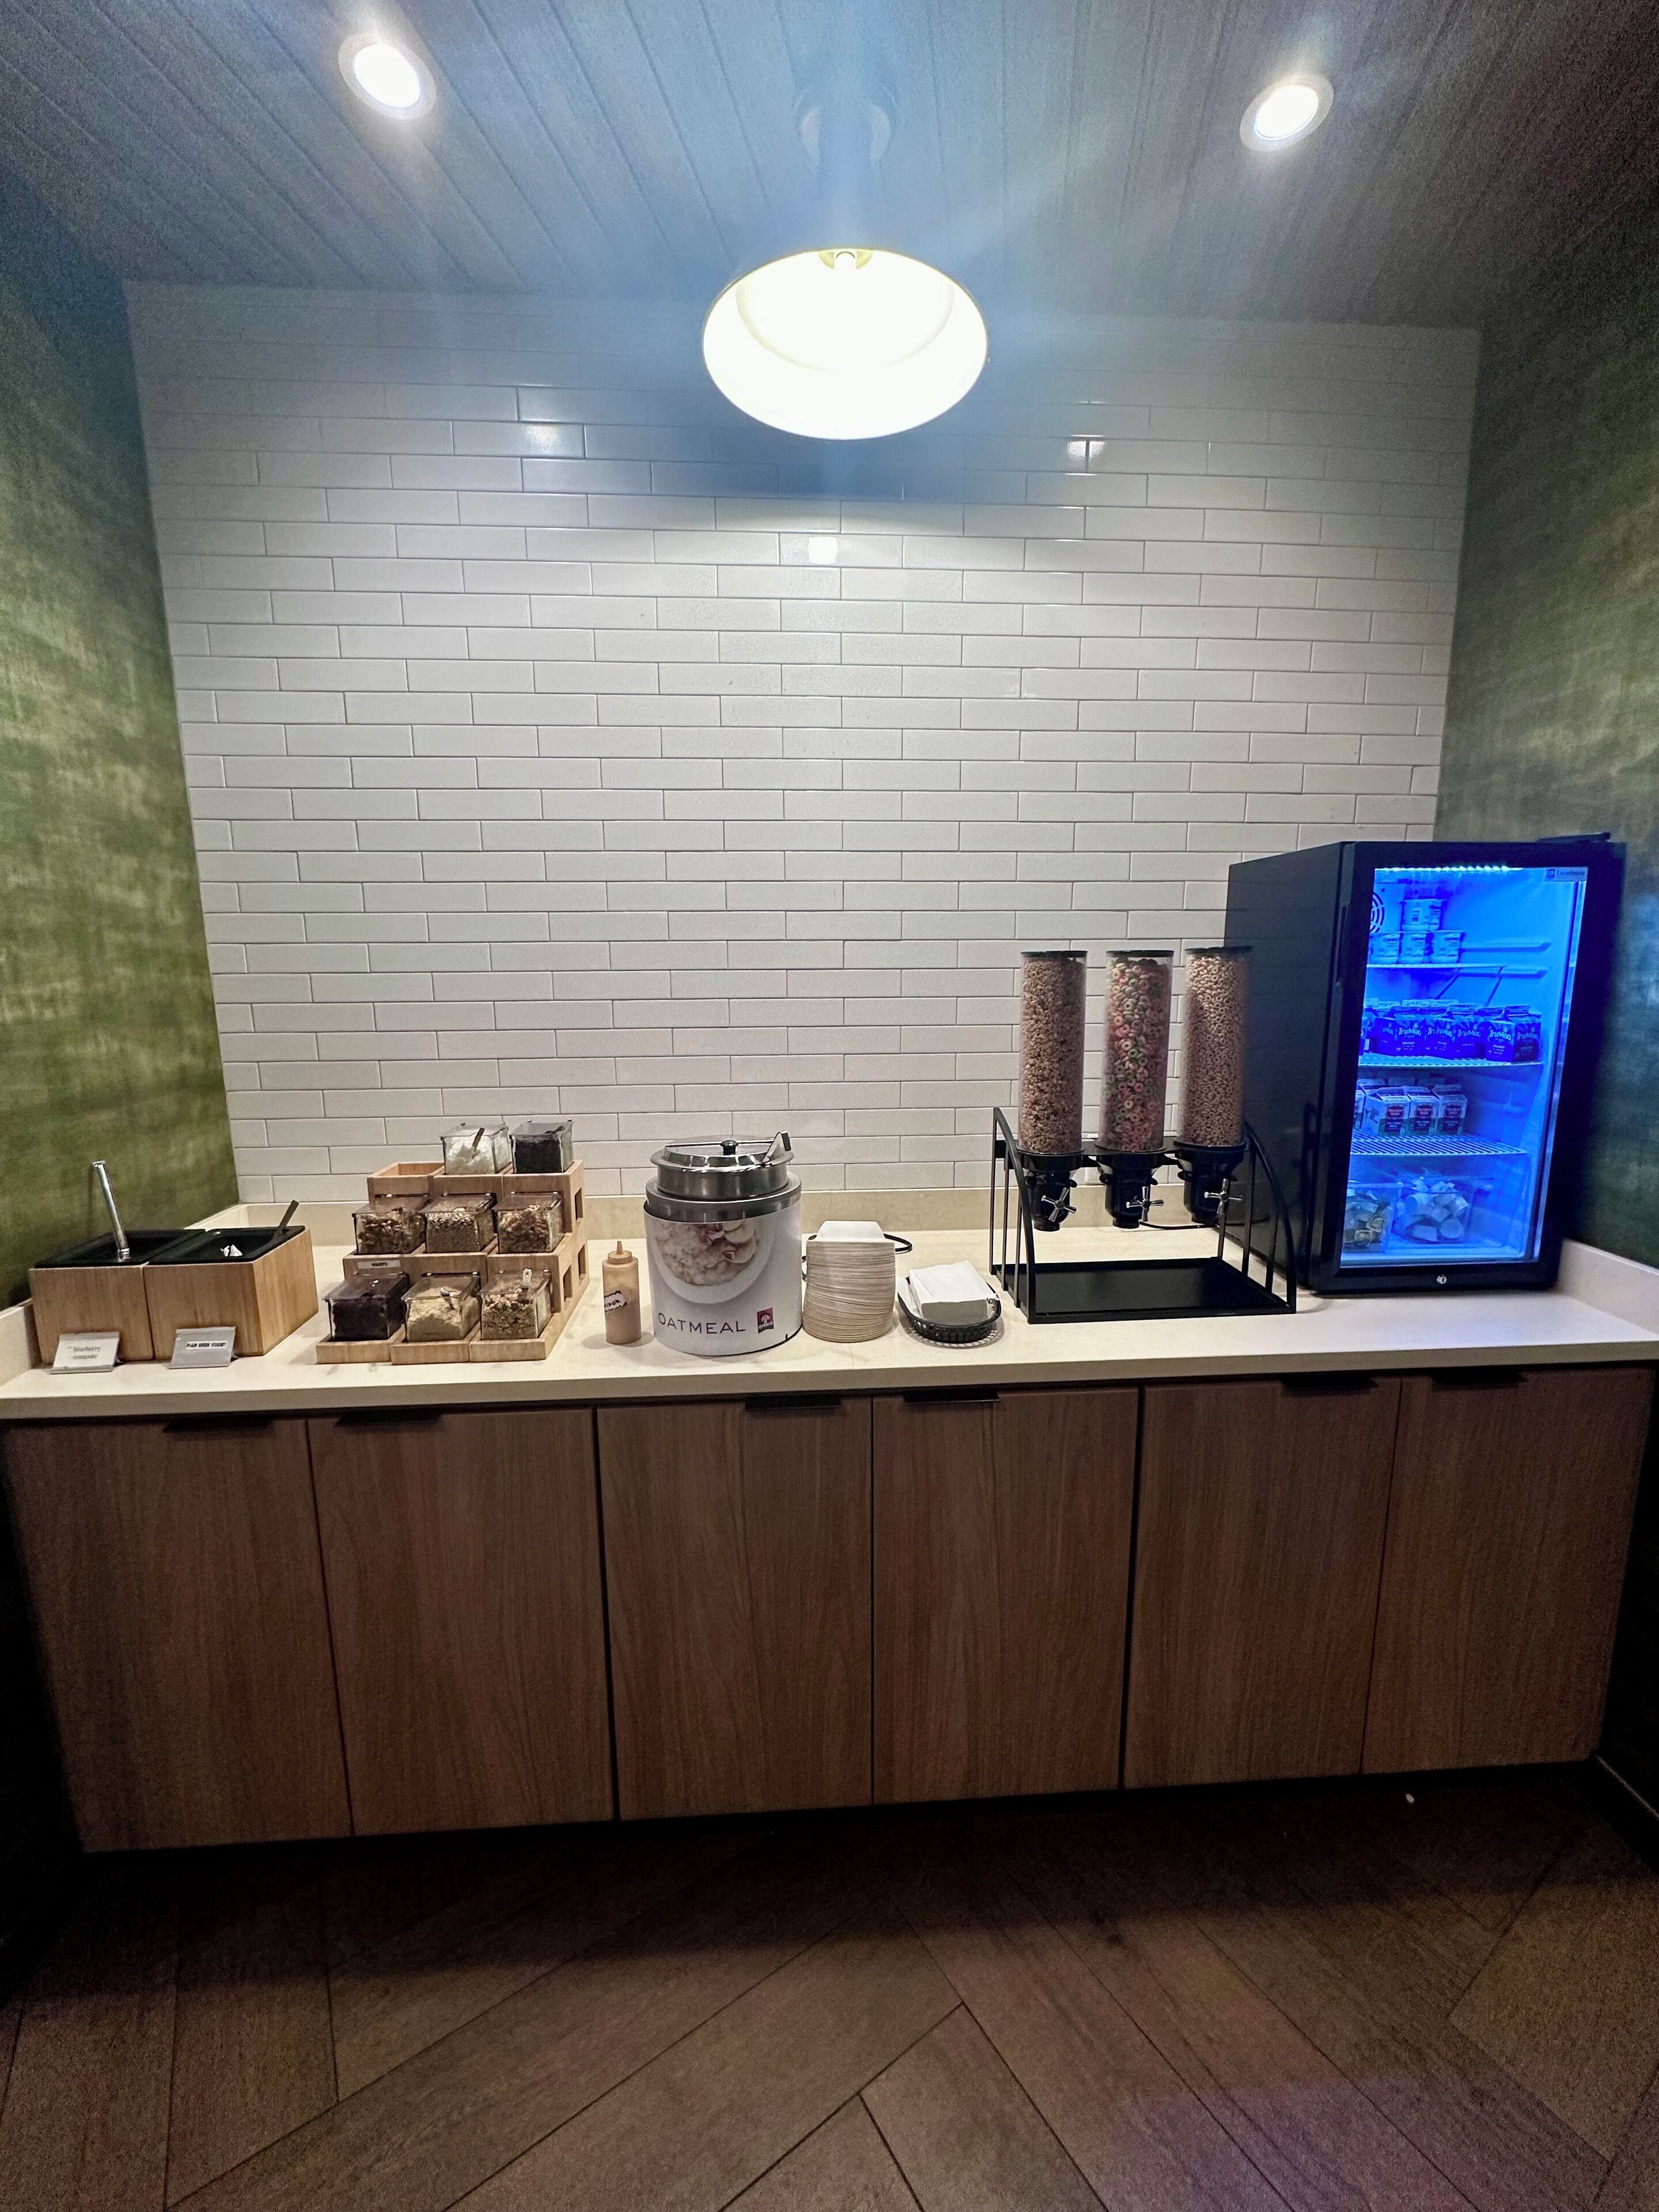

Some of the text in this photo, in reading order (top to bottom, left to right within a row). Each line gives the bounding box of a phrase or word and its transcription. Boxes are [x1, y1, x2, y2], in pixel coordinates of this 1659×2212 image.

[1398, 1027, 1422, 1036] TruMoo
[1457, 1029, 1481, 1037] TruMoo
[1488, 1029, 1512, 1041] TruMoo
[1516, 1032, 1539, 1041] TruMoo
[658, 1312, 746, 1335] OATMEAL
